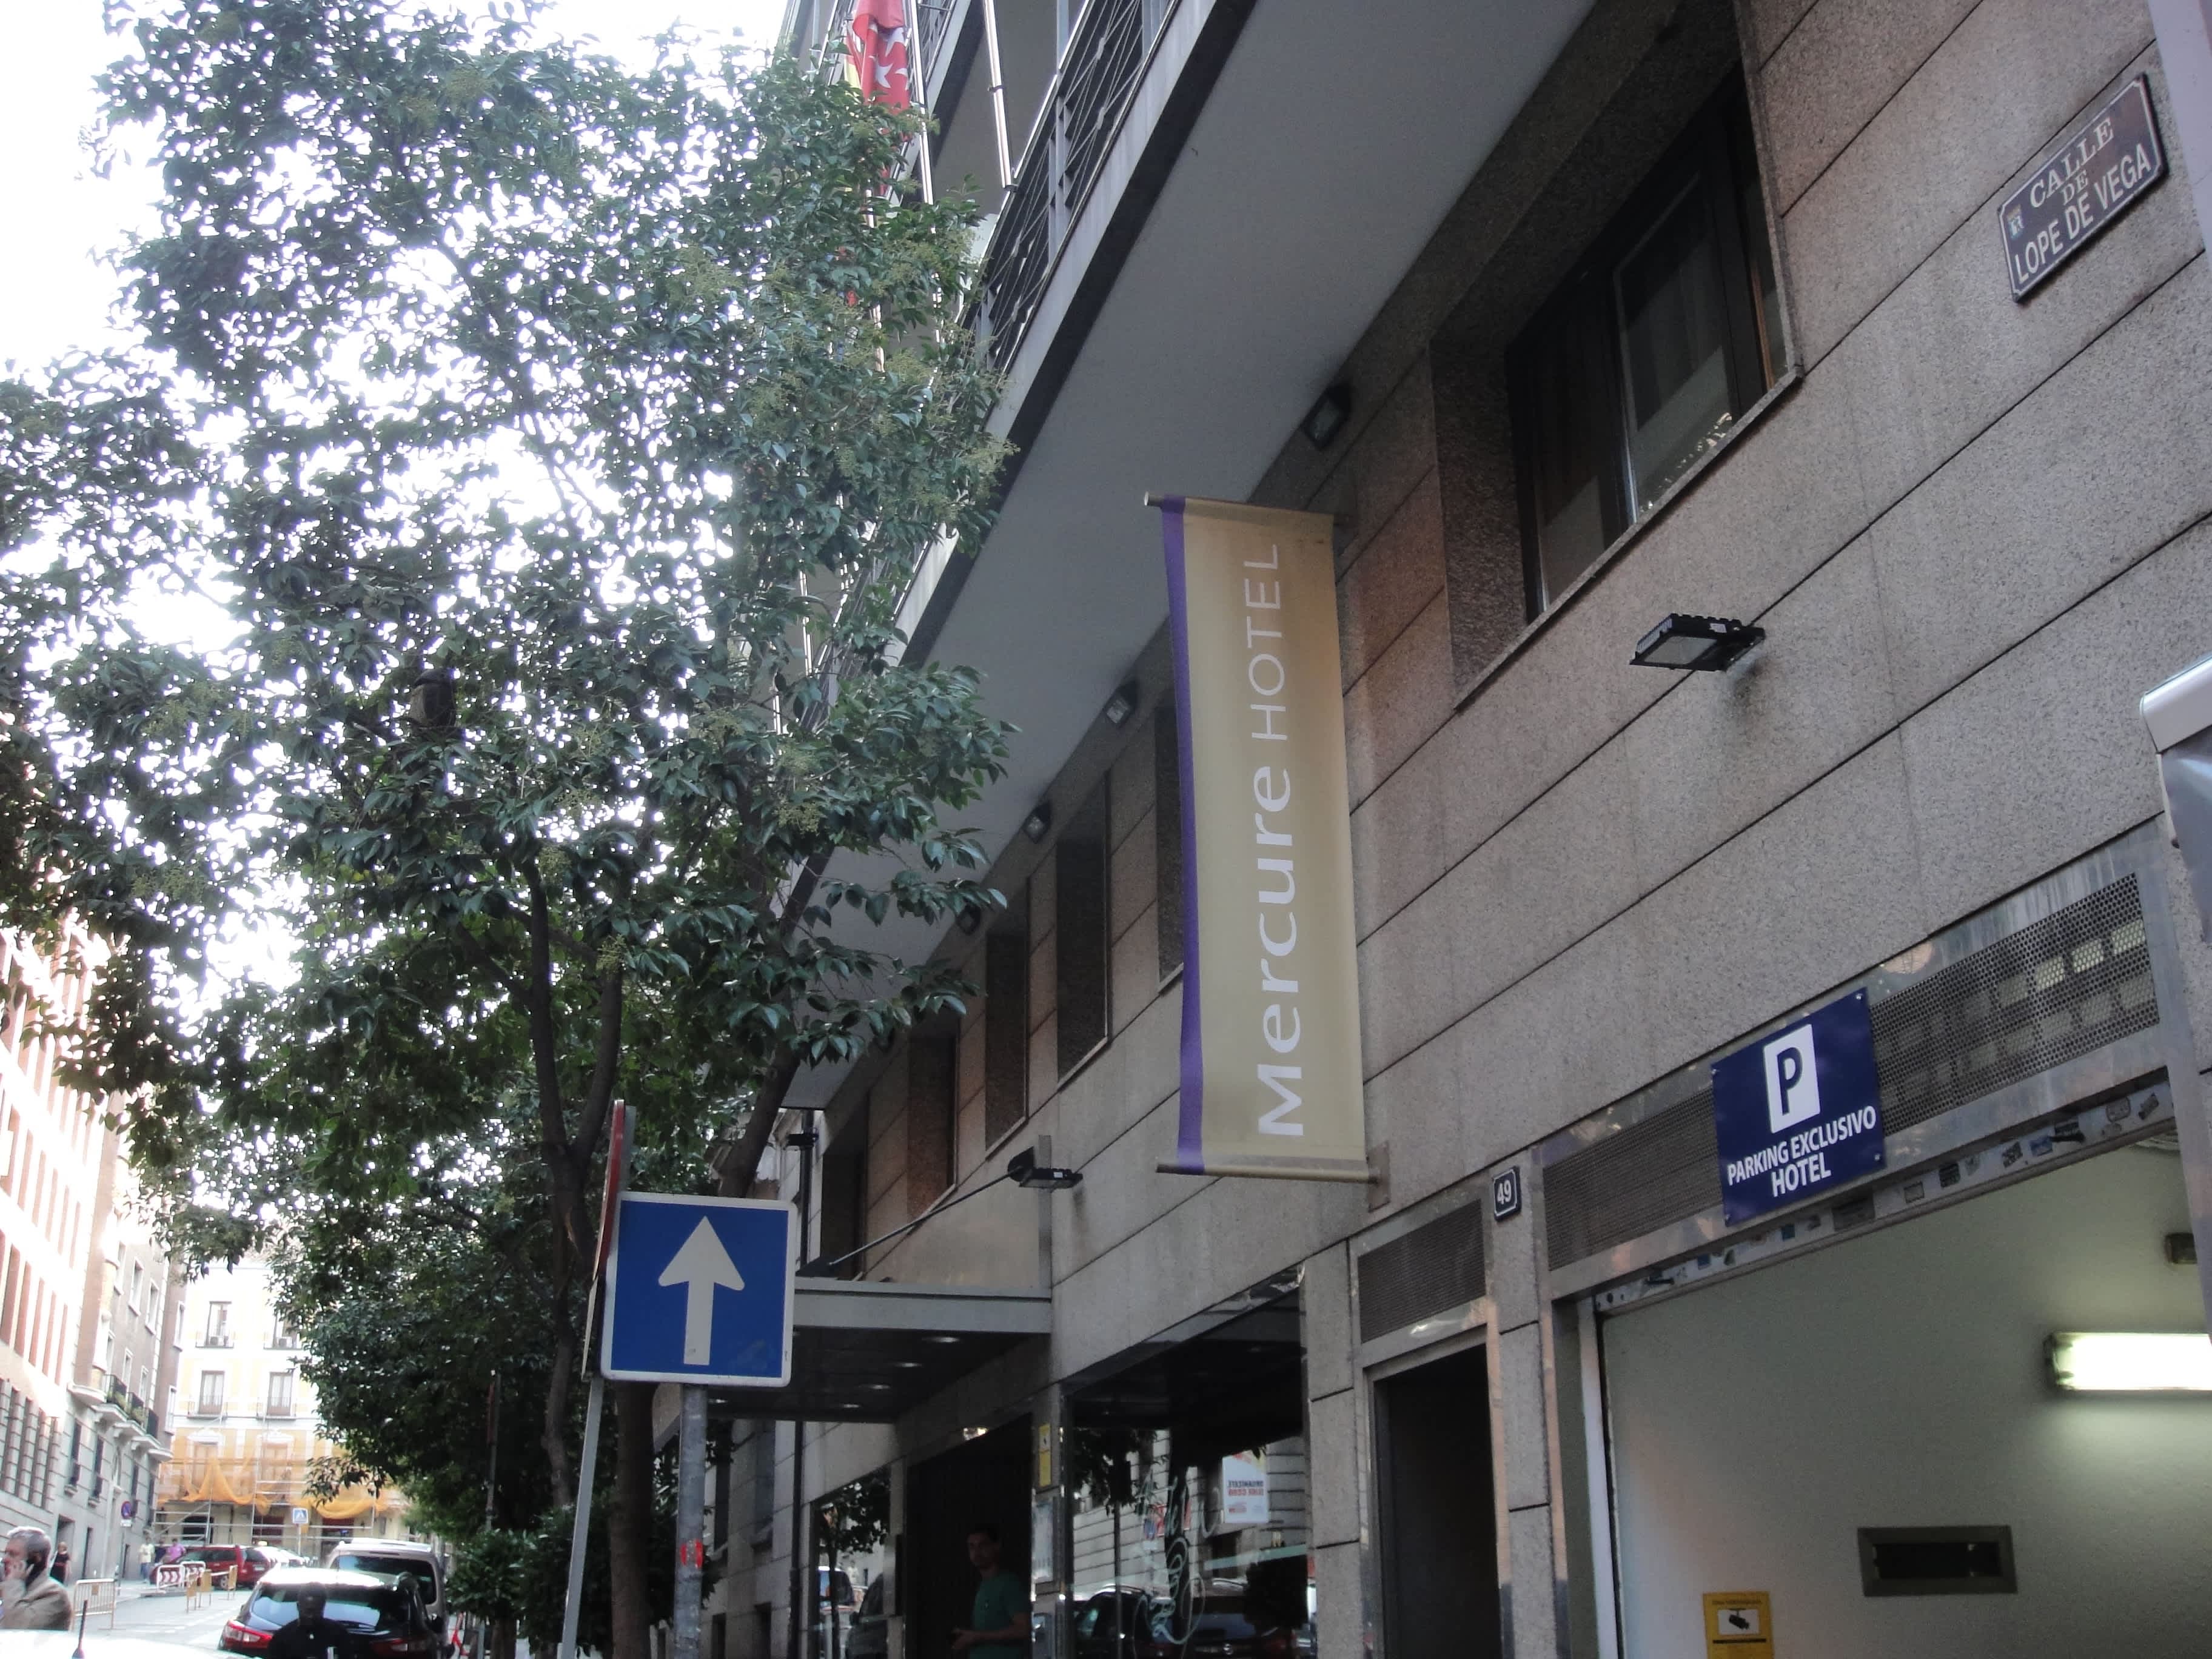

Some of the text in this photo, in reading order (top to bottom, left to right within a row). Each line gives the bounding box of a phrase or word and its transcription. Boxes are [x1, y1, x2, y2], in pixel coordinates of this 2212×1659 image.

[2029, 117, 2114, 208] CALLE
[2062, 170, 2089, 205] DE
[2014, 143, 2151, 284] LOPE DE VEGA
[1244, 544, 1304, 1138] Mercure HOTEL
[1777, 1047, 1803, 1116] P
[1727, 1105, 1877, 1186] PARKING EXCLUSIVO
[1771, 1152, 1831, 1198] HOTEL
[1497, 1179, 1512, 1205] 49
